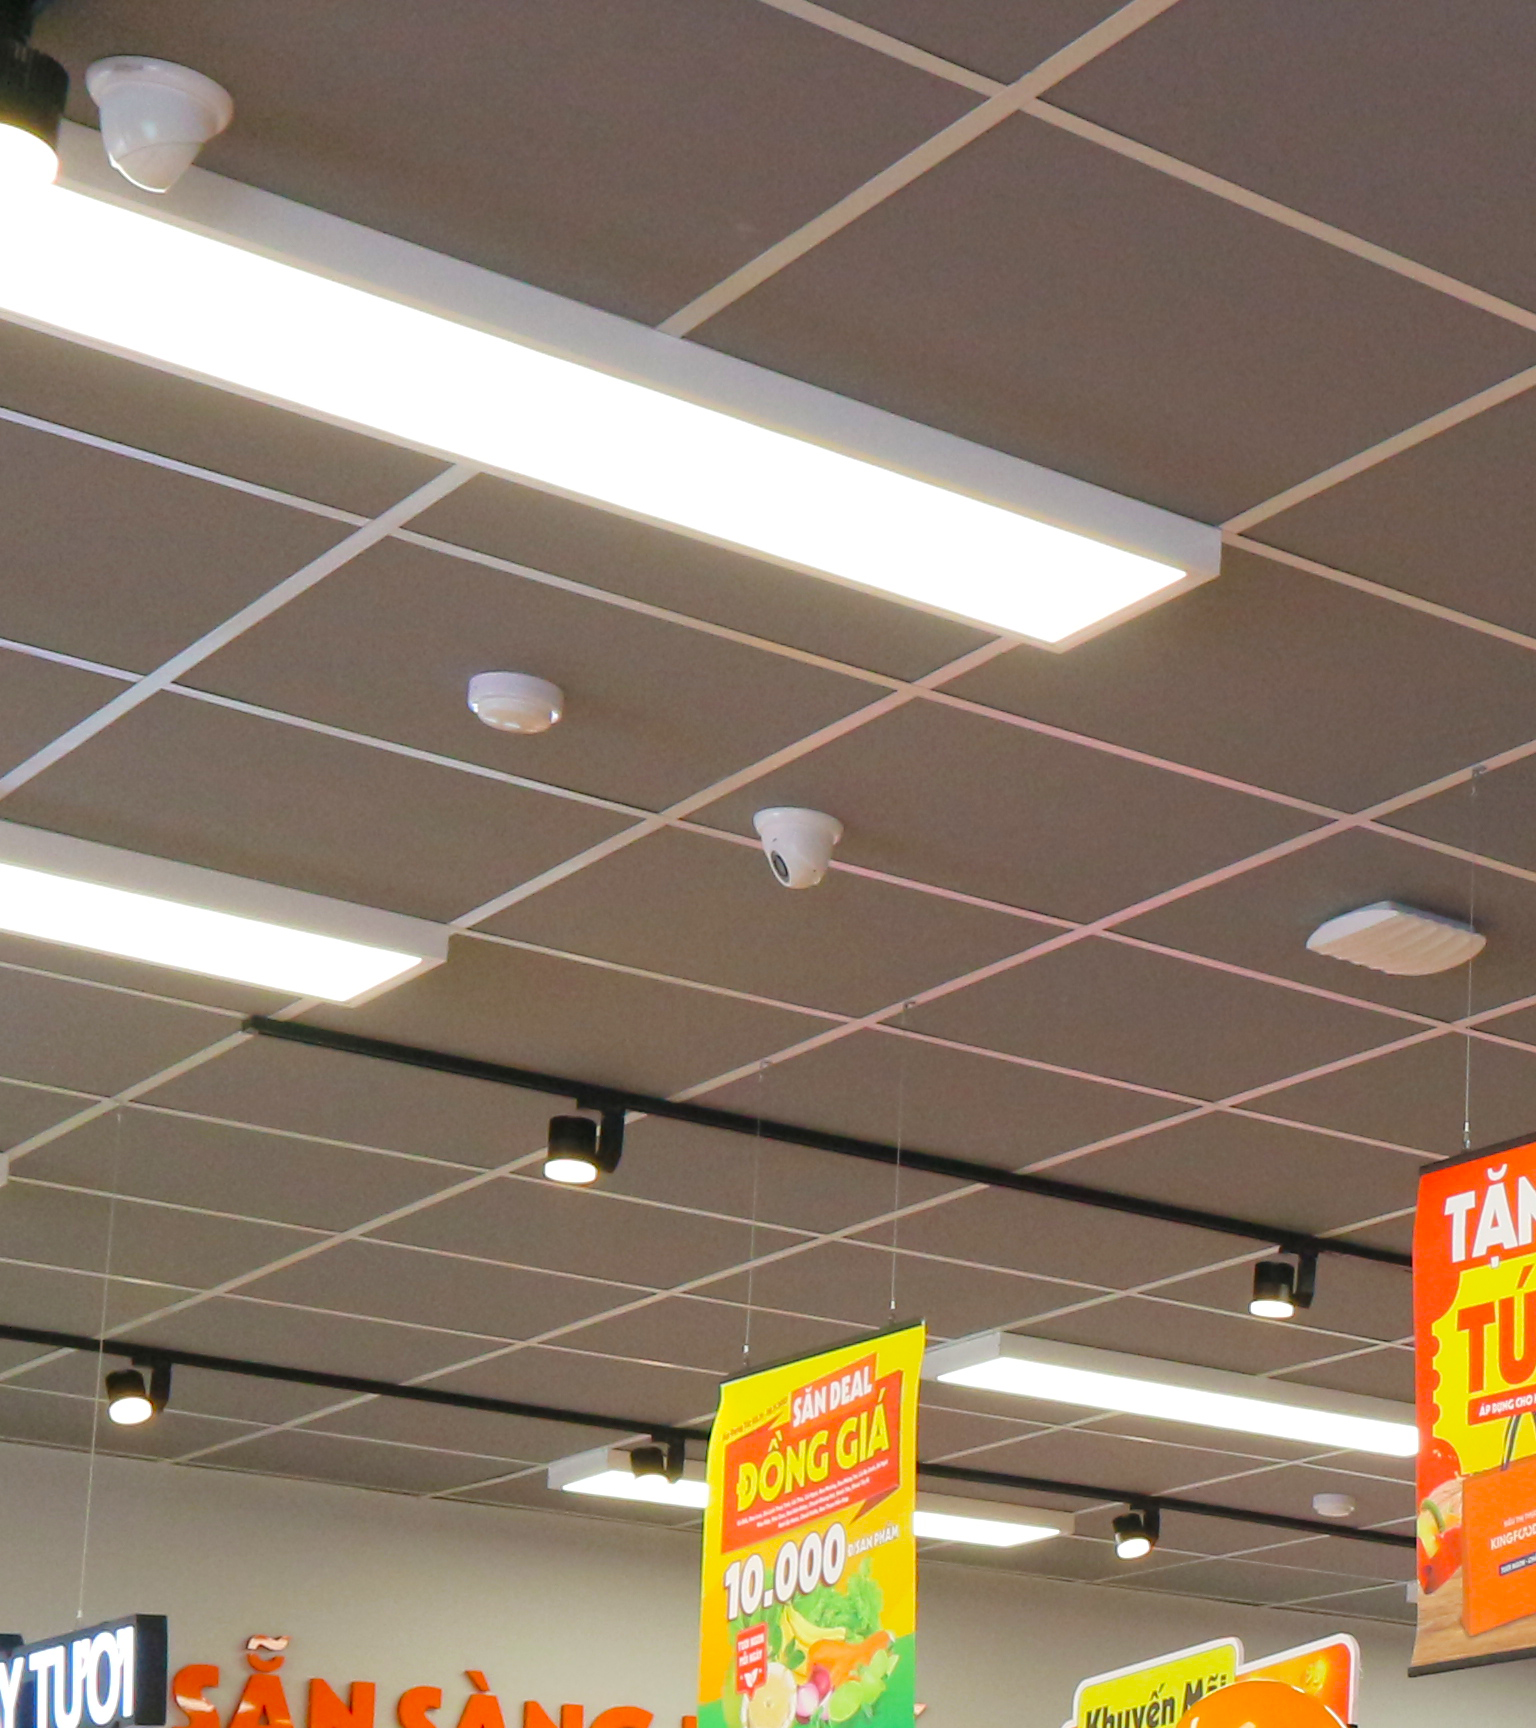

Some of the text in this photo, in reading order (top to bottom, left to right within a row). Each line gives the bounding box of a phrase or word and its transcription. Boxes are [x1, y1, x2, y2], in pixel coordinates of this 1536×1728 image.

[793, 1386, 826, 1427] SĂN
[830, 1366, 872, 1411] DEAL
[737, 1431, 829, 1511] ĐỒNG
[836, 1387, 889, 1470] GIÁ
[725, 1522, 846, 1621] 10.000
